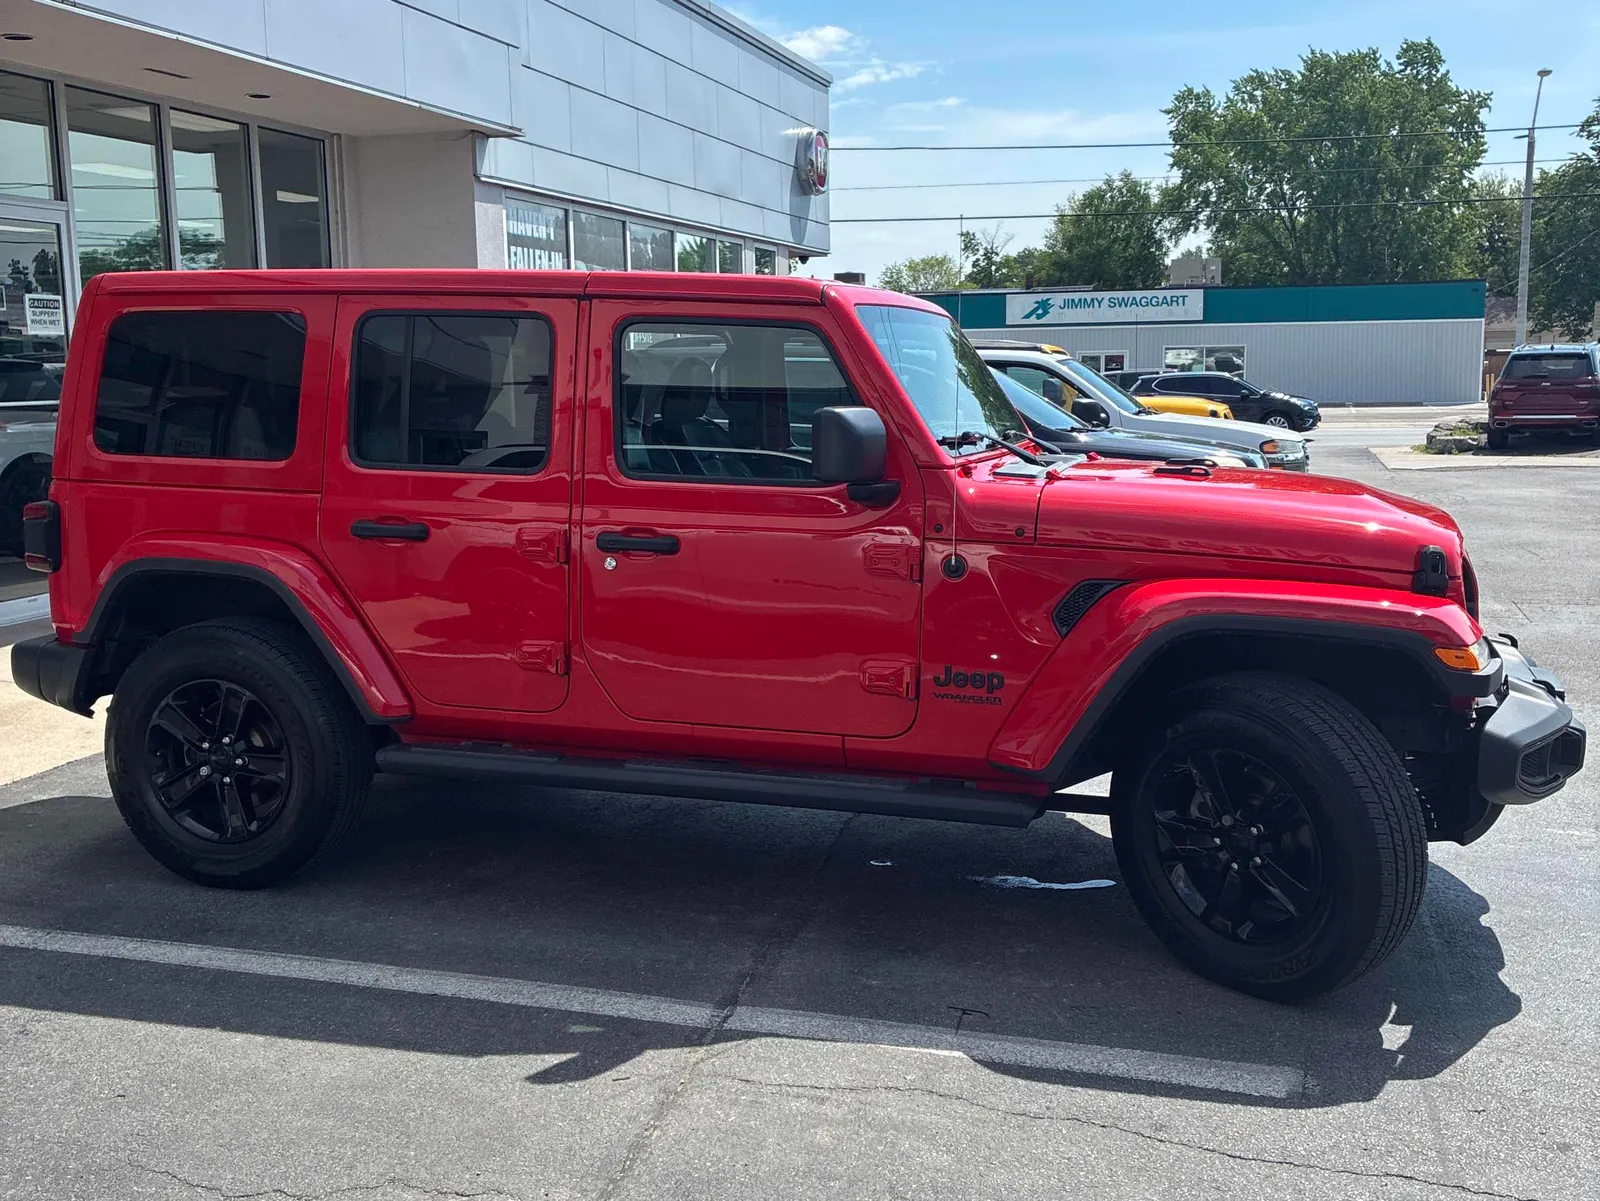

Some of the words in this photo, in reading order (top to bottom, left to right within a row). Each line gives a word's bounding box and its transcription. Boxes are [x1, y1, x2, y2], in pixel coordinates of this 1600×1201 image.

[29, 299, 60, 308] CAUTION
[1059, 297, 1104, 310] JIMMY
[1107, 295, 1188, 308] SWAGGART
[31, 310, 58, 318] SLIPPERY
[1057, 308, 1190, 319] ministries
[933, 664, 1005, 694] Jeep
